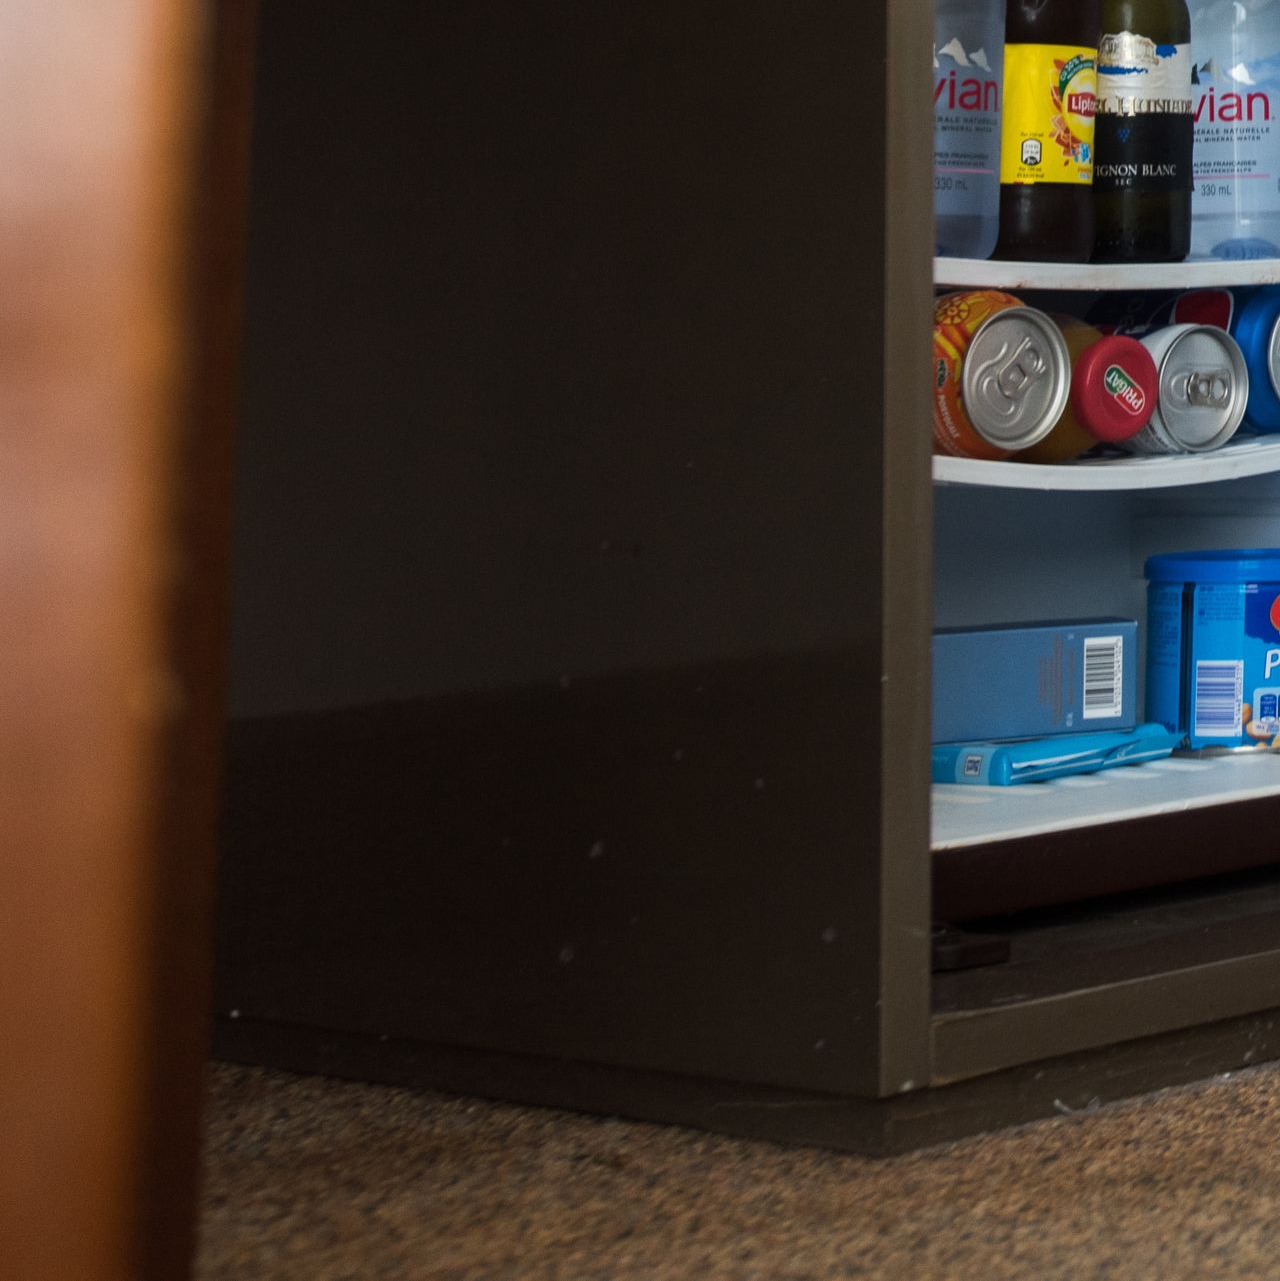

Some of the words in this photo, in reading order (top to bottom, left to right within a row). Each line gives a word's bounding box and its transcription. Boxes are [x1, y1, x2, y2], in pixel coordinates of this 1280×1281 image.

[932, 70, 999, 112] vian
[1193, 86, 1271, 123] vian
[1095, 163, 1138, 177] IGNON
[1141, 163, 1177, 177] BLANC
[1200, 183, 1216, 197] 330
[1217, 183, 1232, 196] mL
[1106, 369, 1144, 411] PRIGAT
